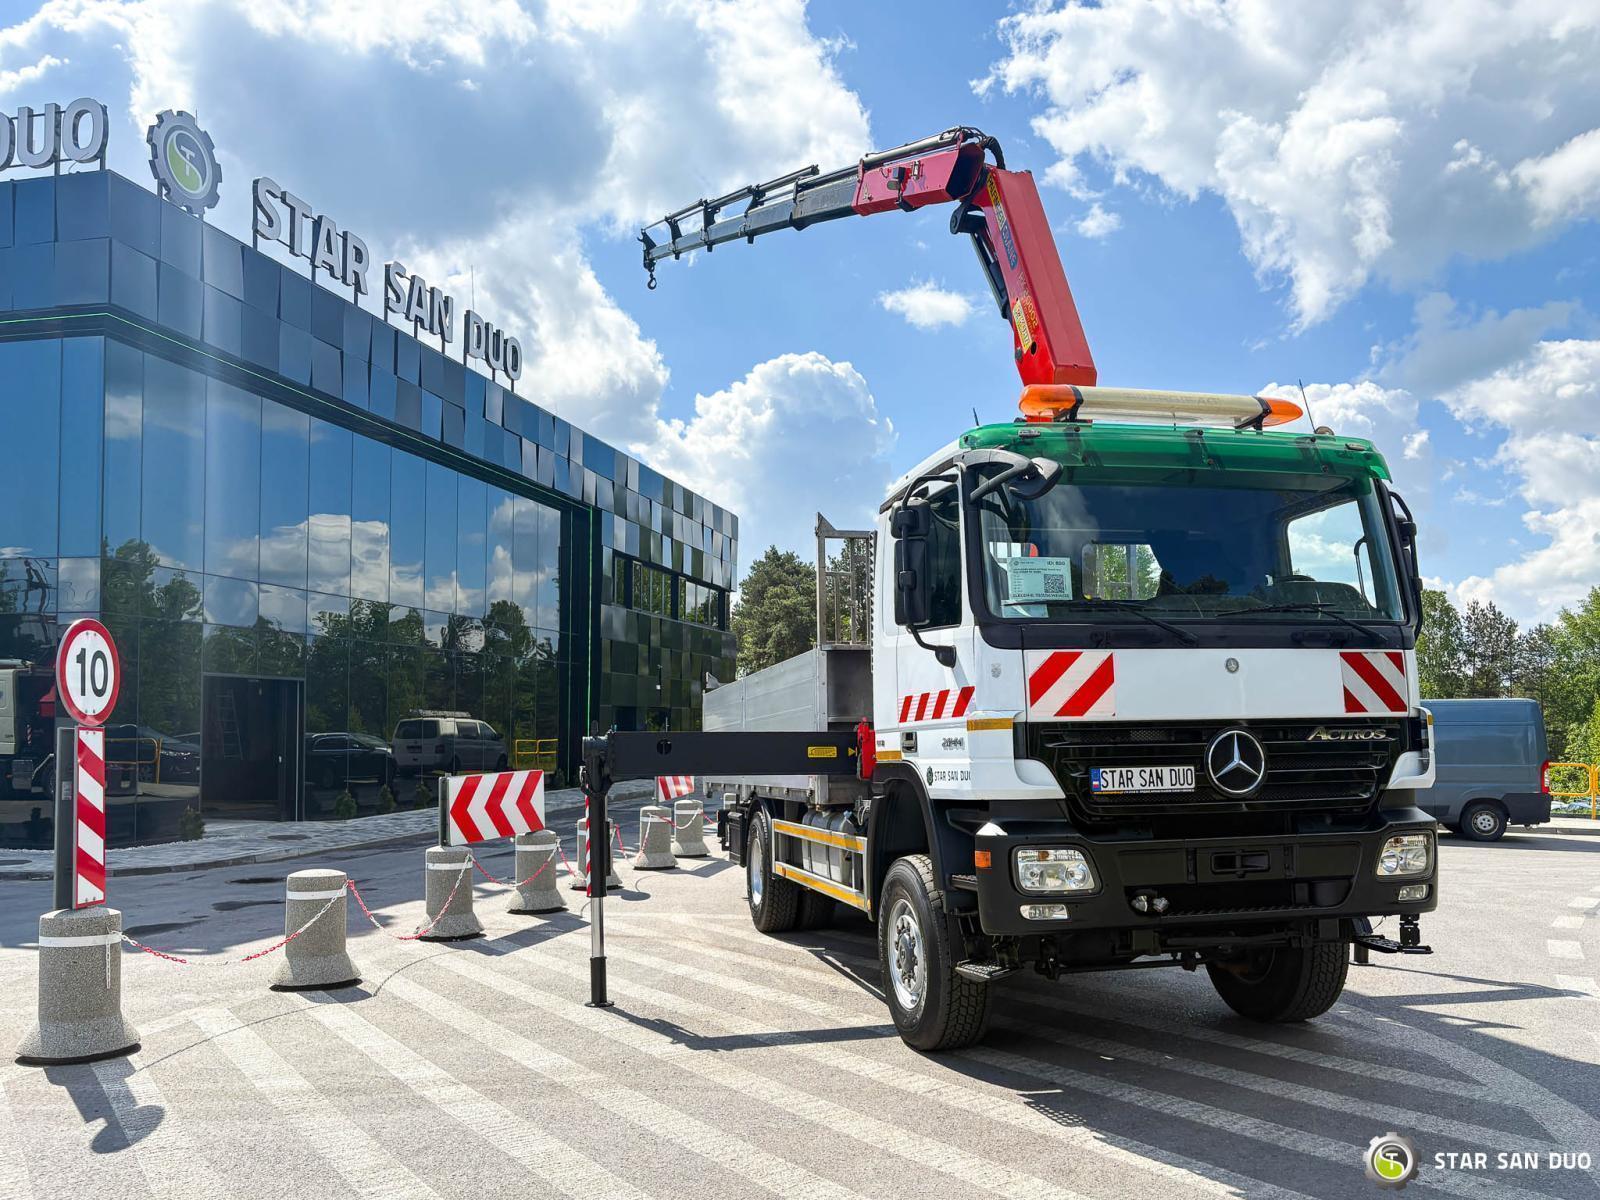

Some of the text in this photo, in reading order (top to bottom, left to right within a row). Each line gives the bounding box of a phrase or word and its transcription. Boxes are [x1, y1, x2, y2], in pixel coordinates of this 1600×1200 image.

[252, 176, 523, 380] STAR SAN DUO
[75, 647, 109, 698] 10
[934, 770, 946, 781] STAR
[947, 770, 959, 781] SAN
[1101, 767, 1193, 788] STAR SAN DUO
